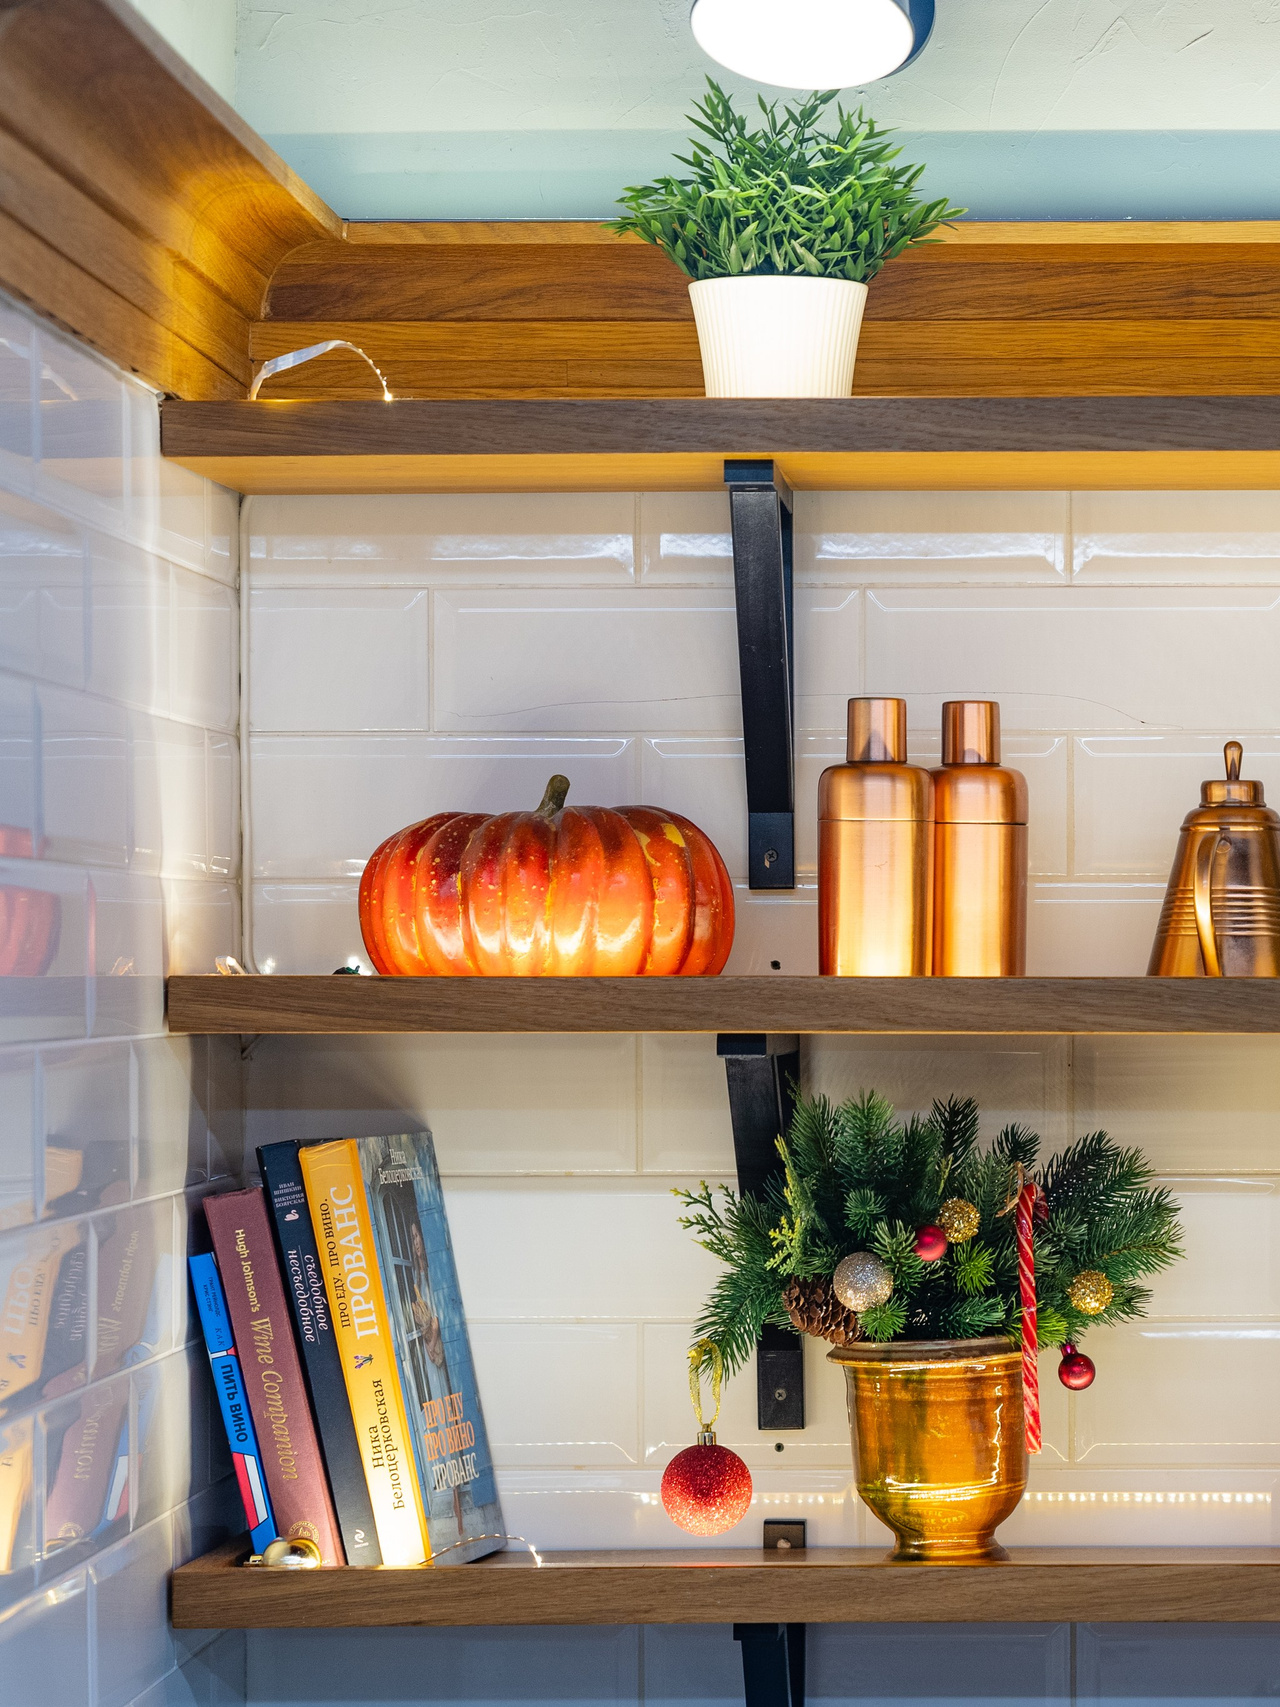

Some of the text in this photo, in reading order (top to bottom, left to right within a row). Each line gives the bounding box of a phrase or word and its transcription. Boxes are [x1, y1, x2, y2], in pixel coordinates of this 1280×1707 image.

[389, 1149, 407, 1166] Ника
[274, 1193, 304, 1203] ВИКТОРИЯ
[275, 1198, 305, 1208] БОЯРСКАЯ
[326, 1247, 340, 1268] ПРО
[329, 1184, 380, 1340] ПРОВАНС
[287, 1249, 316, 1343] несъедобное
[304, 1254, 329, 1331] съедобное
[338, 1304, 351, 1329] ПРО
[234, 1229, 298, 1480] Hugh Johnson's Wine Companion
[215, 1327, 248, 1442] КАК ПИТЬ ВИНО
[423, 1392, 464, 1429] ПРО ЕДУ
[369, 1424, 385, 1469] Ника
[372, 1378, 406, 1511] Белоцерковская
[423, 1420, 475, 1461] ПРО ВИНО
[432, 1452, 480, 1493] ПРОВАНС
